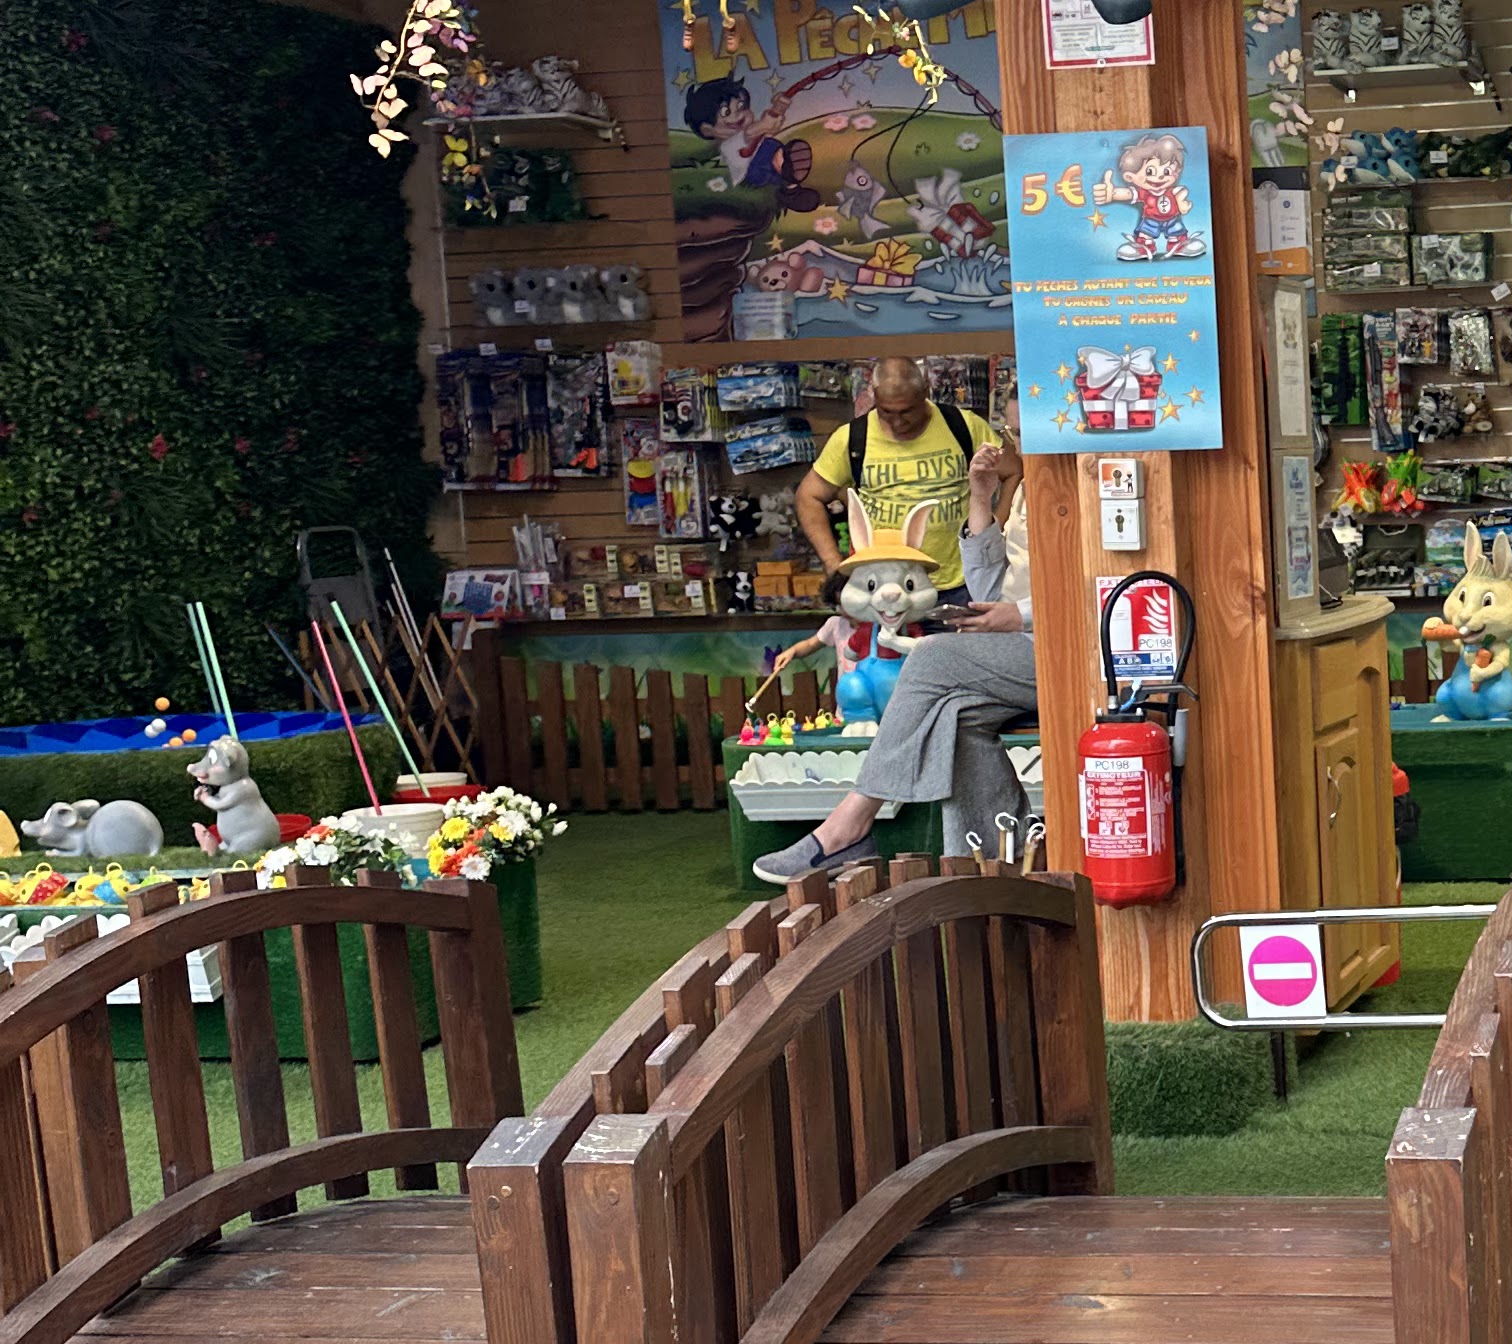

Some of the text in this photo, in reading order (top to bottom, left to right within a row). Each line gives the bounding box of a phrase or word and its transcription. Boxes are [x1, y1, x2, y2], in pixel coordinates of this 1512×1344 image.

[1014, 281, 1033, 293] TU
[1082, 277, 1131, 291] AUTANT
[1134, 277, 1158, 289] QUE
[1161, 275, 1180, 287] TU
[1181, 274, 1212, 287] VEUX
[1043, 292, 1189, 308] TU GAGNES UN CADEAU
[1072, 314, 1122, 327] CHAQUE
[1129, 312, 1178, 325] PARTIE
[1139, 638, 1172, 648] PC198
[1095, 760, 1129, 770] PC198
